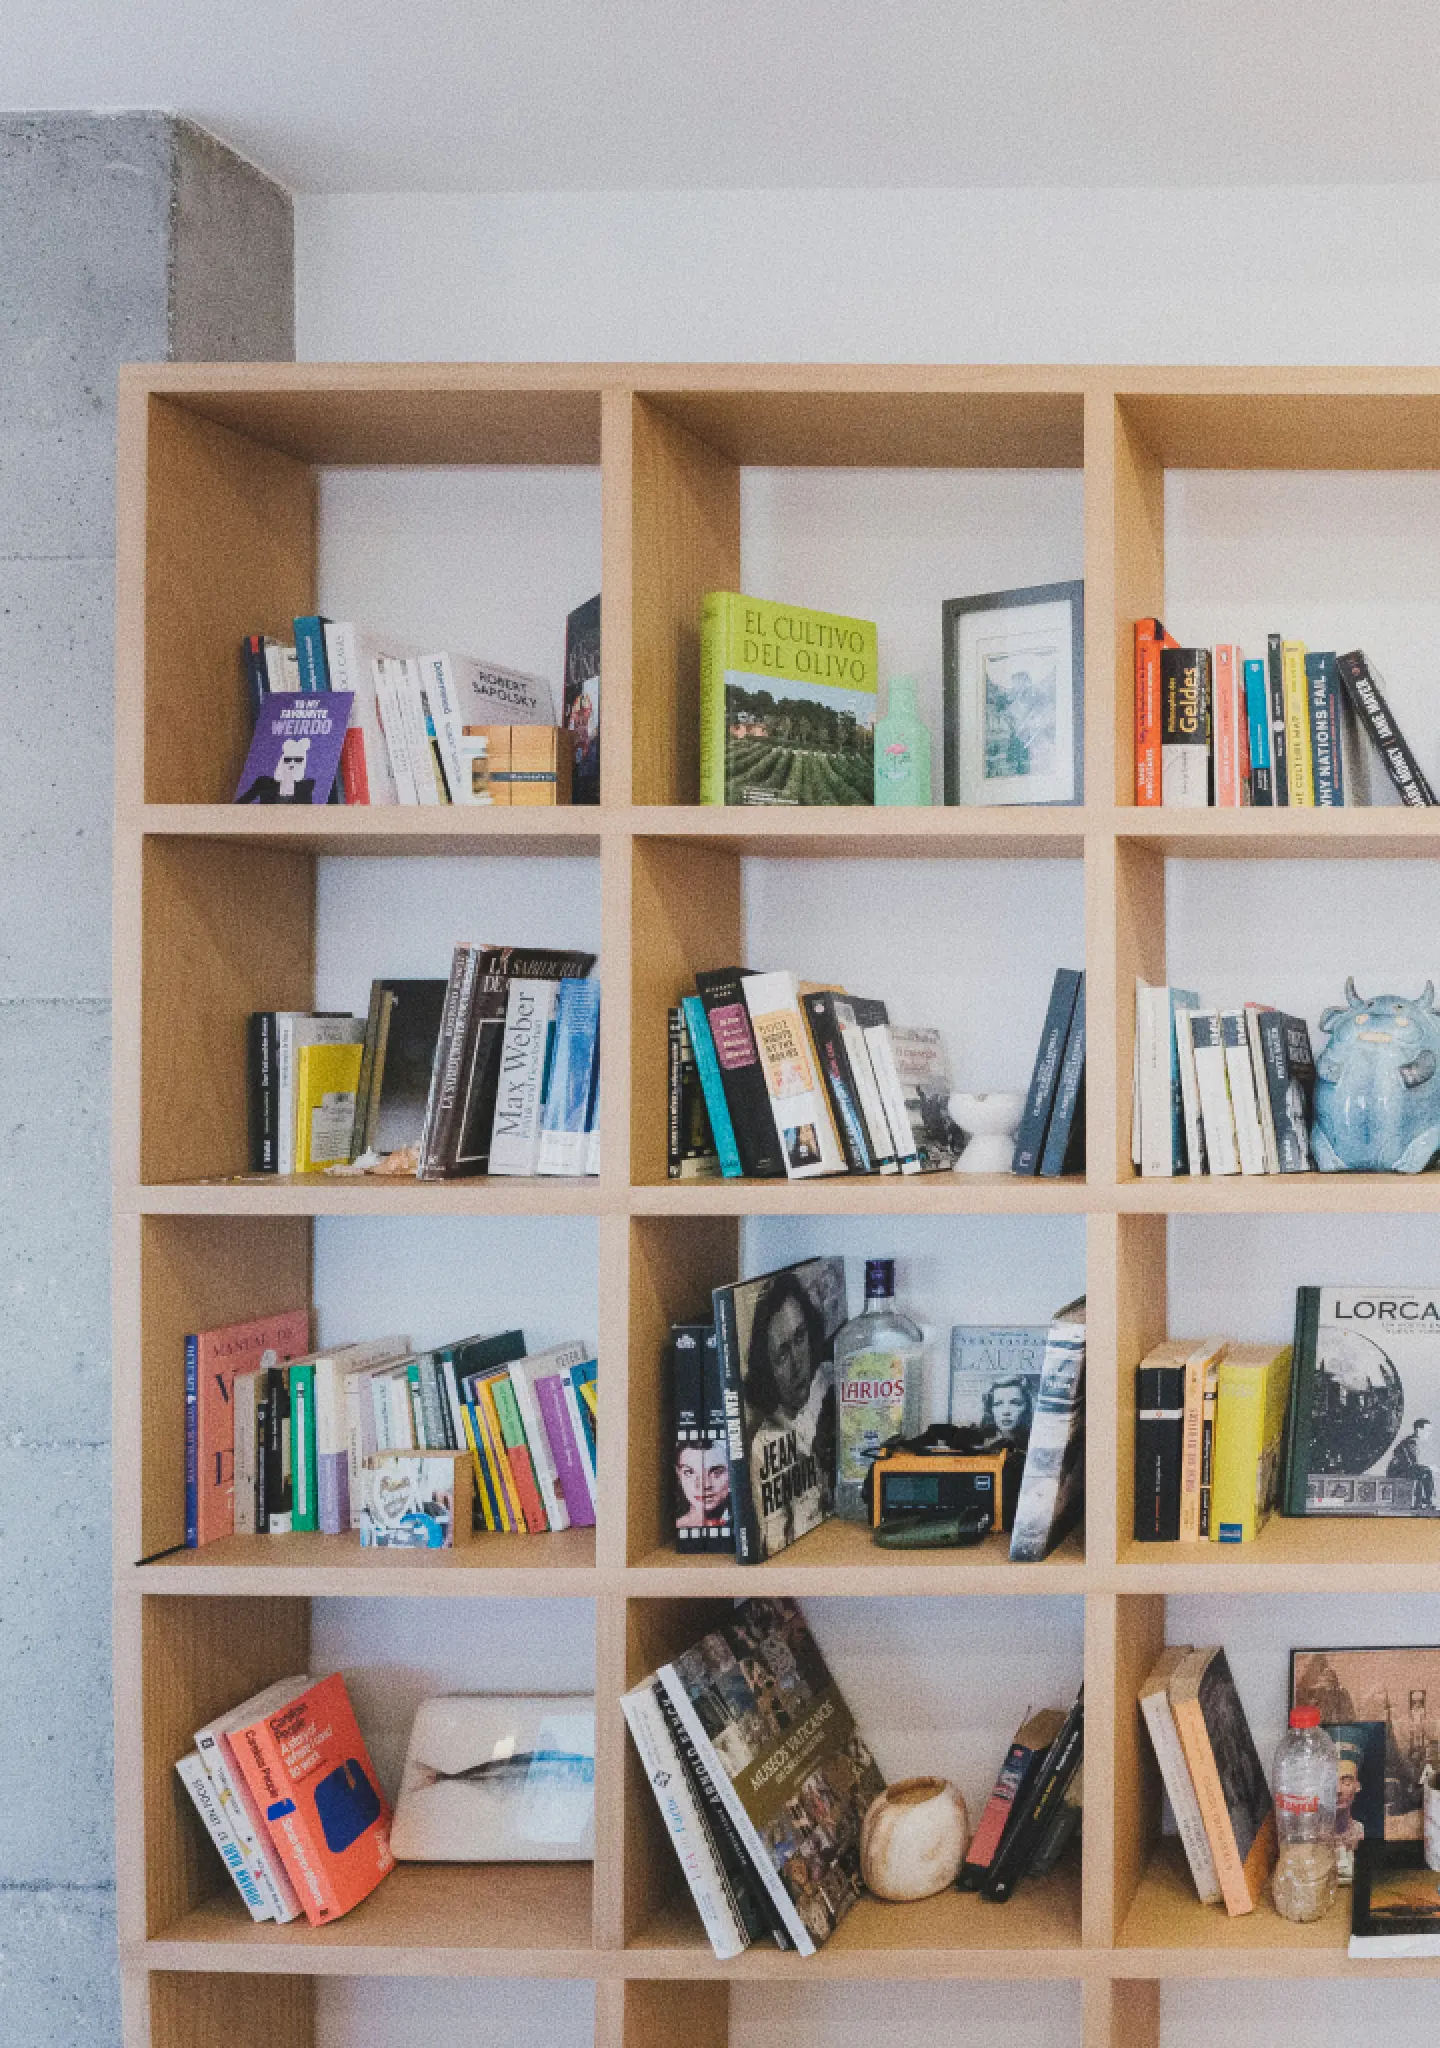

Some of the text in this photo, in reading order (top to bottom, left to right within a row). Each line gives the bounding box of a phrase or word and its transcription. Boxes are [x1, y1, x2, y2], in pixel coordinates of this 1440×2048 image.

[744, 609, 865, 654] EL CULTIVO
[479, 671, 527, 694] ROBERT
[743, 640, 866, 684] DEL OLIVO
[306, 699, 321, 709] MY
[471, 682, 537, 708] SAPOLSKY
[1179, 667, 1198, 733] Geldes
[1313, 675, 1327, 707] FAIL
[271, 719, 333, 735] WEIRDO
[280, 709, 329, 719] FAVOURITE
[1291, 715, 1301, 739] MAP
[1315, 710, 1331, 776] NATIONS
[1294, 742, 1303, 789] CULTURE
[496, 991, 535, 1136] Max Weber
[1335, 1300, 1440, 1321] LORCA
[723, 1388, 741, 1416] JEAN
[841, 1379, 904, 1402] LARIOS
[727, 1418, 745, 1460] RENOIR
[760, 1430, 797, 1480] JEAN
[762, 1455, 817, 1517] RENOIR
[751, 1745, 790, 1792] MUSEOS
[788, 1699, 835, 1753] VATICANOS
[688, 1746, 723, 1804] ARNOLD
